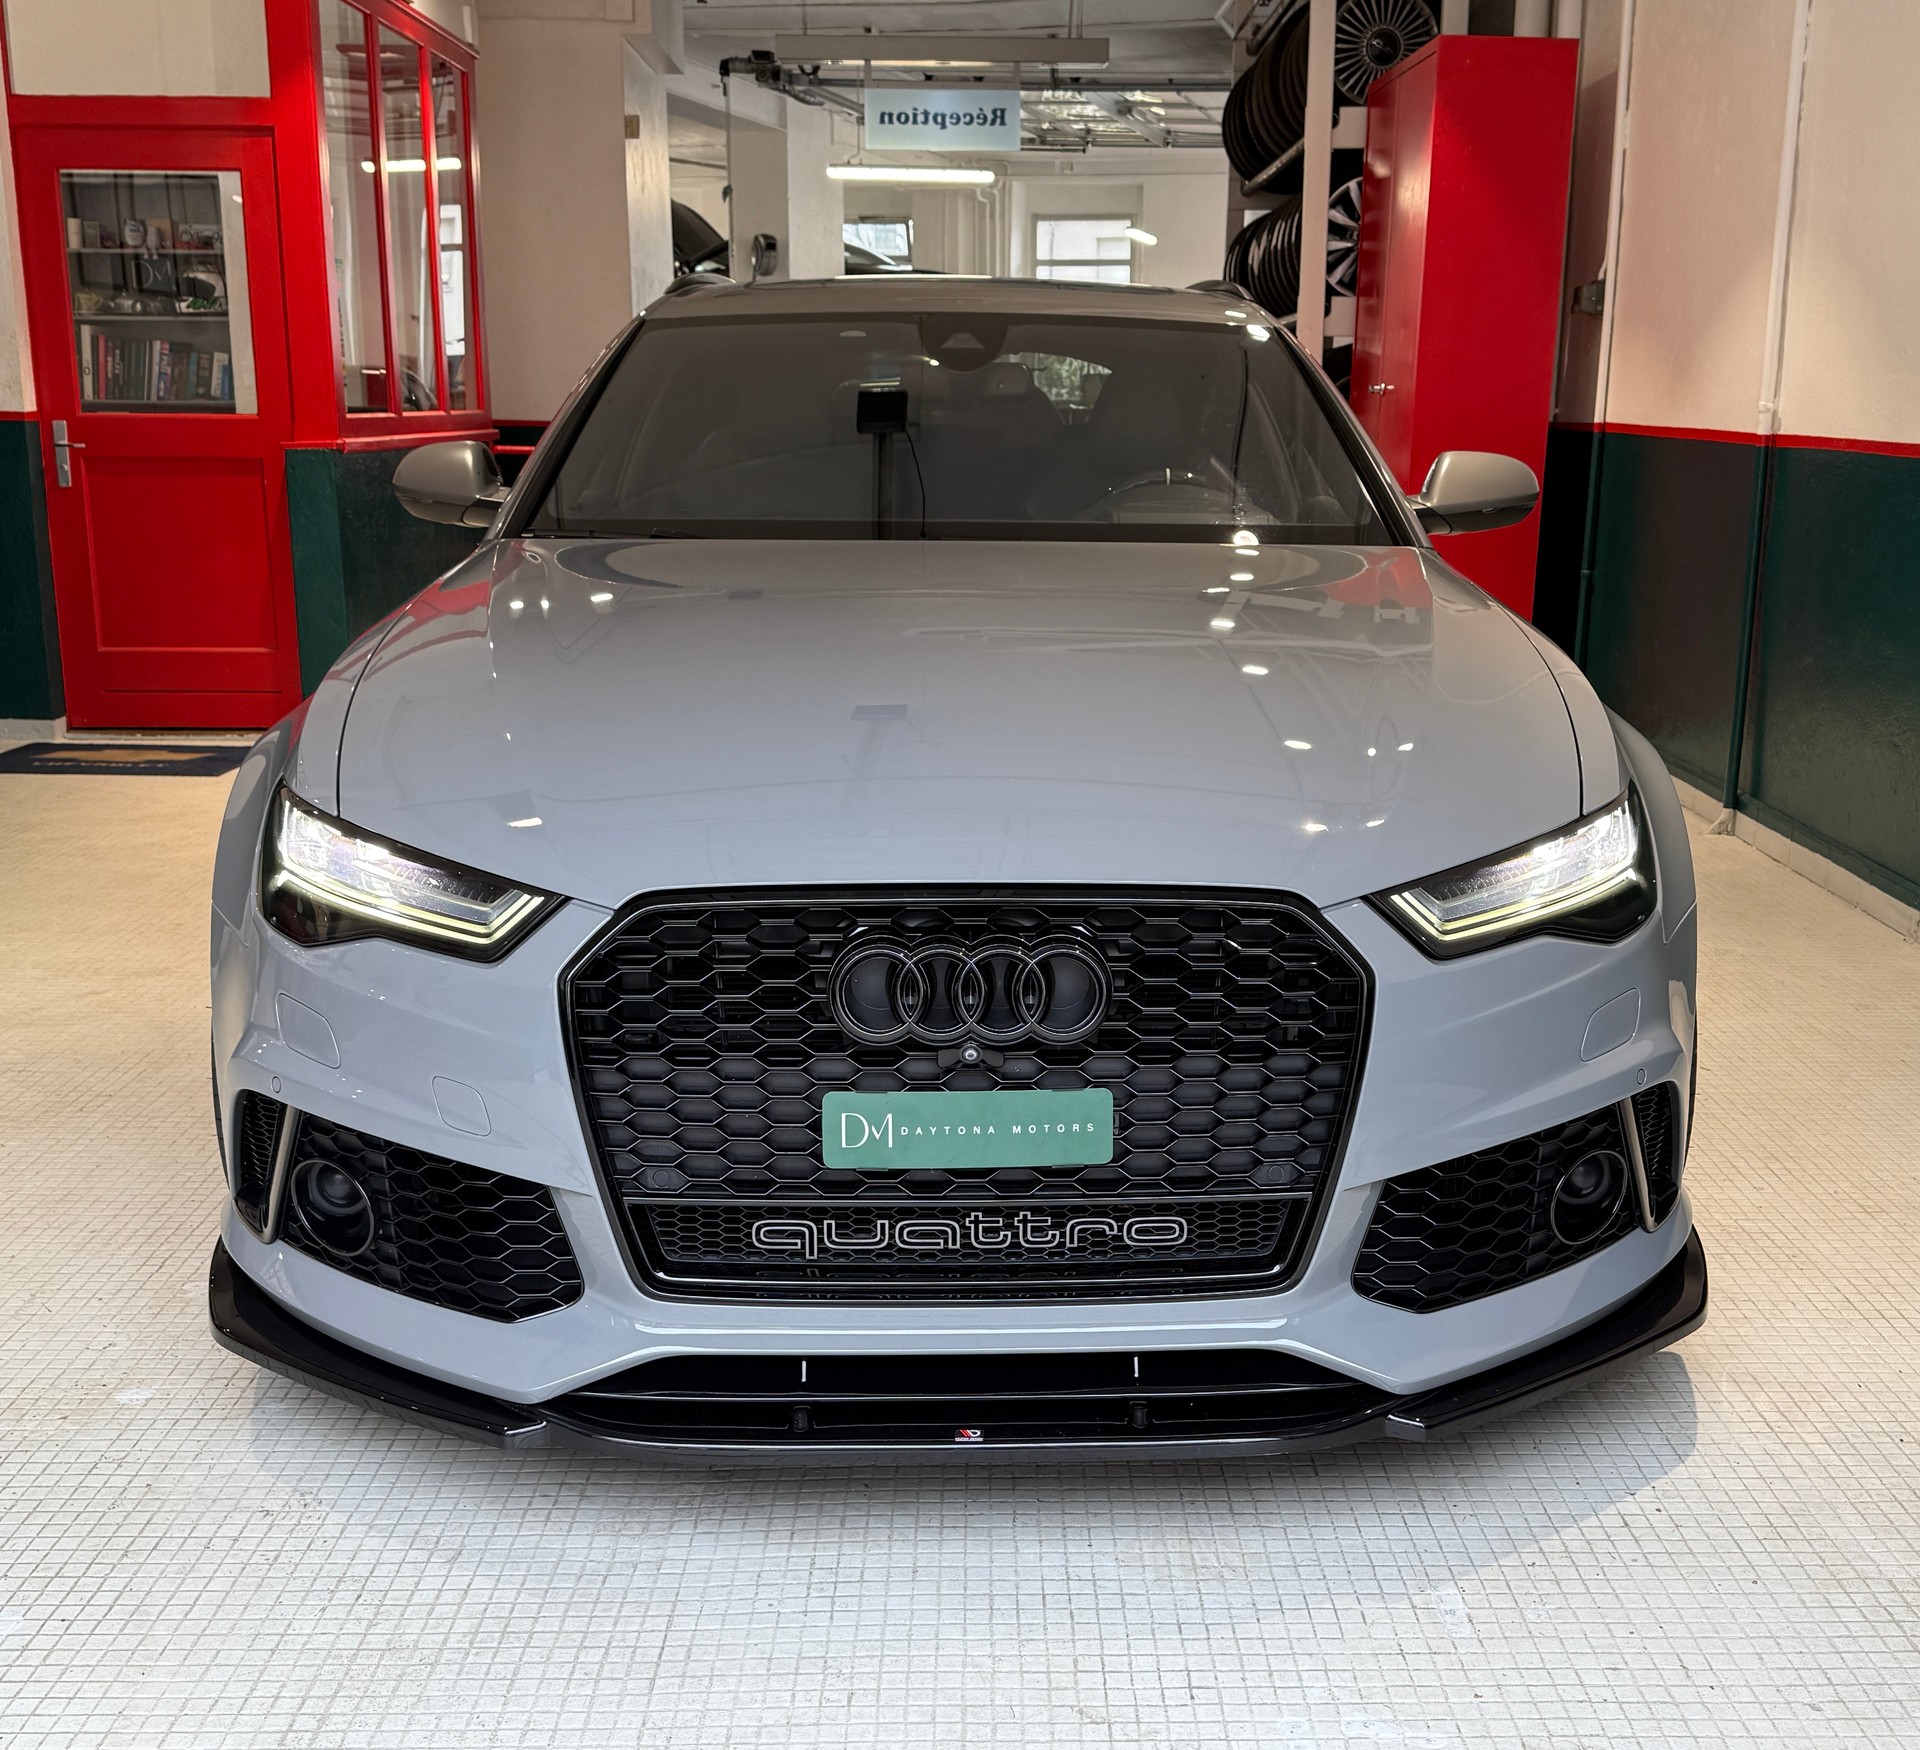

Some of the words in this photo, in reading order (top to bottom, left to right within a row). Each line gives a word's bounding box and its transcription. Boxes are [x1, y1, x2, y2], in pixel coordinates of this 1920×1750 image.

[841, 1112, 893, 1149] DM
[901, 1124, 996, 1136] DAYTONA
[1012, 1122, 1095, 1134] MOTORS
[752, 1211, 1188, 1260] quattro
